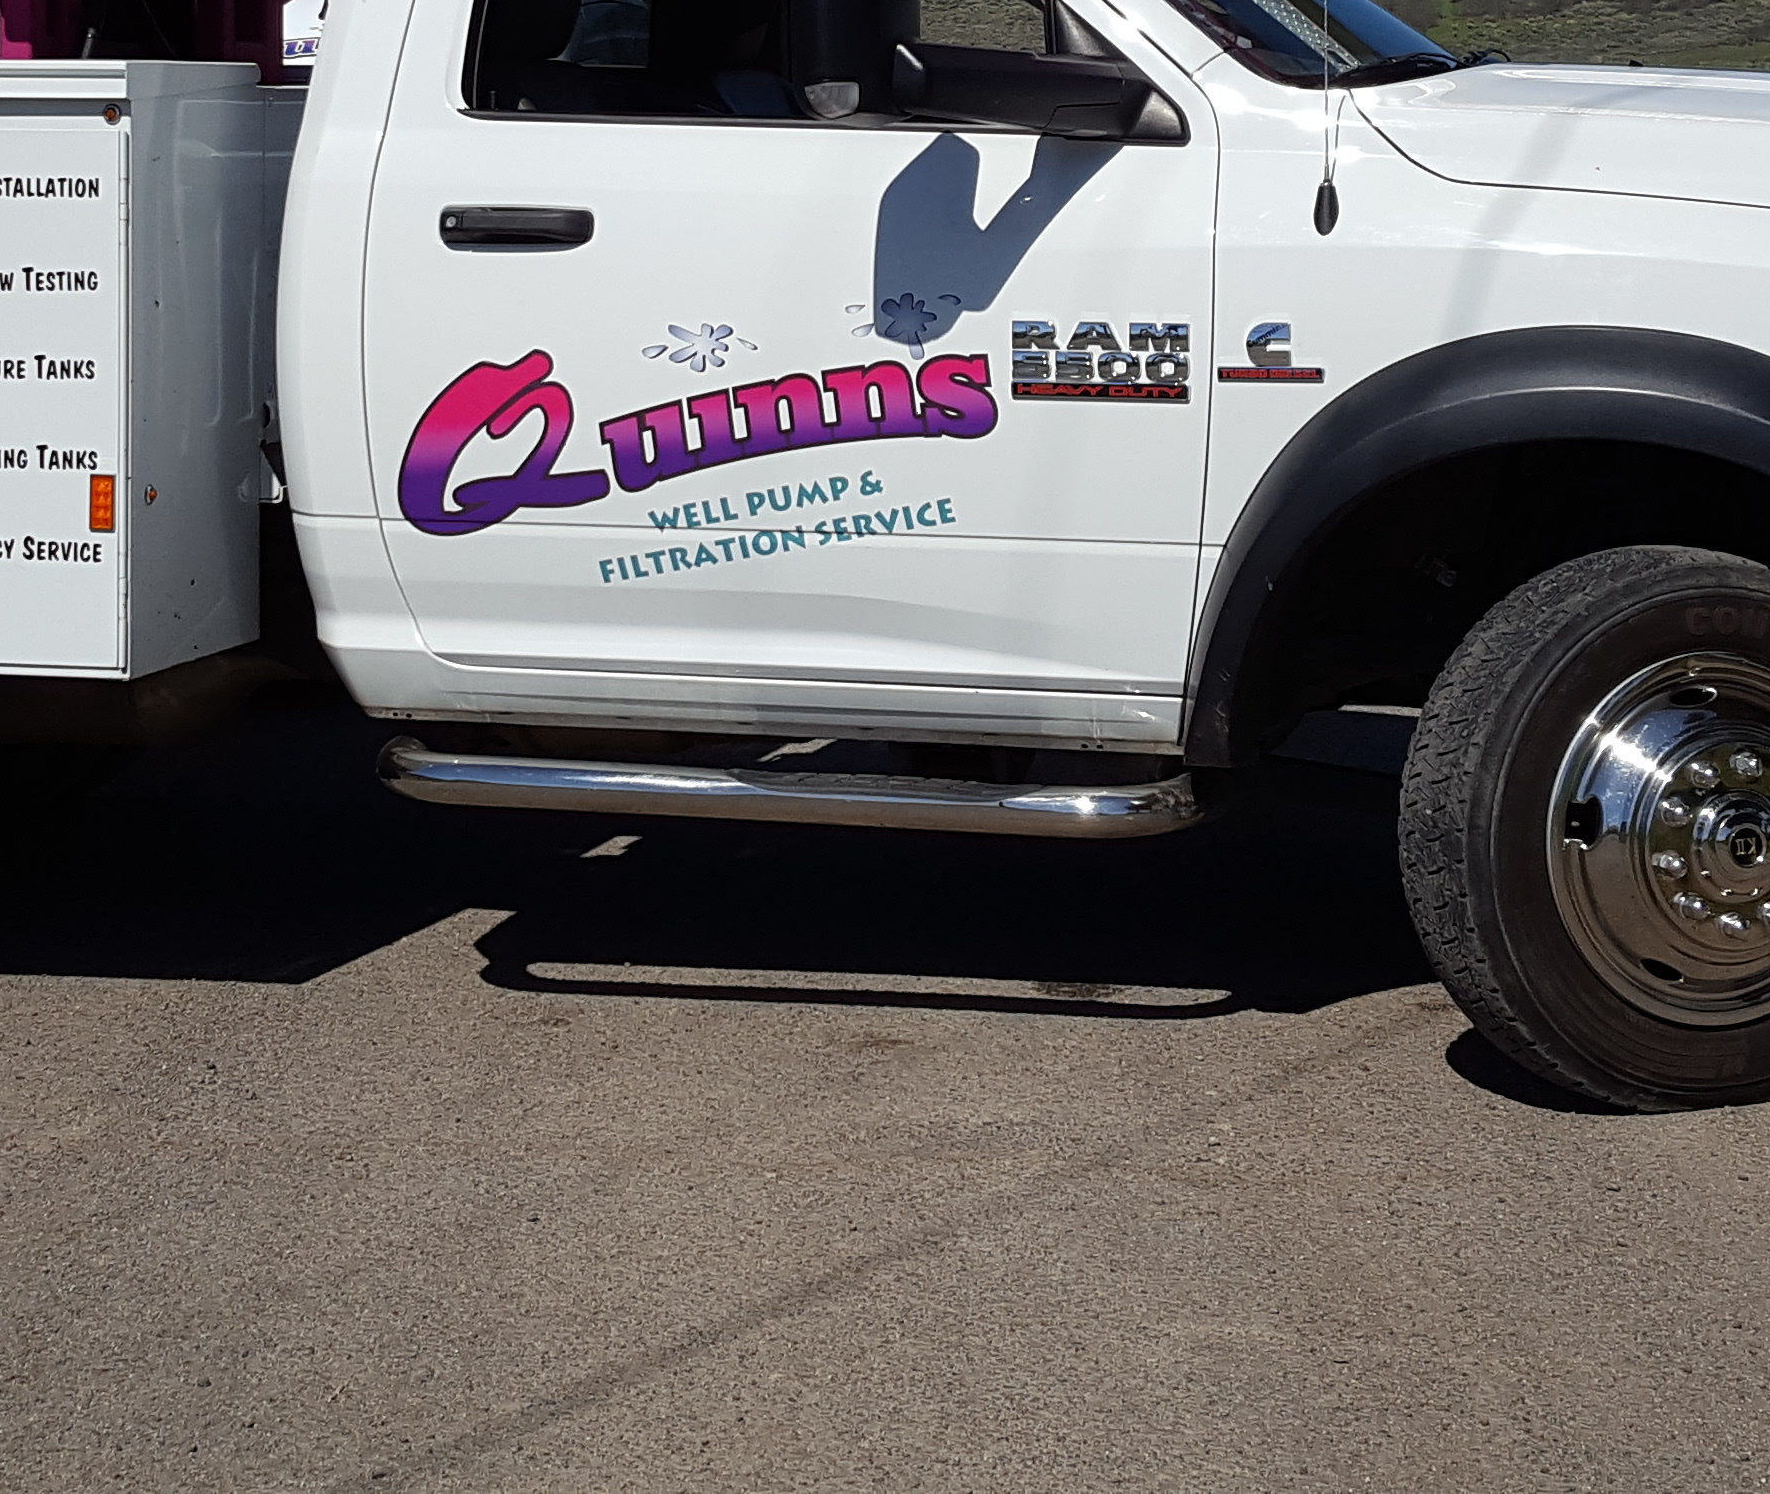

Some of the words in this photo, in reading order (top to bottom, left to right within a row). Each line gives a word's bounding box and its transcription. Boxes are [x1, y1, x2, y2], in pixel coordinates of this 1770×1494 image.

[1011, 320, 1191, 352] RAM
[1011, 350, 1191, 383] 5500
[1016, 383, 1107, 398] HEAVY
[1108, 384, 1183, 399] DUTY
[397, 348, 1000, 538] Quinns
[646, 494, 740, 534] WELL
[747, 478, 852, 518] PUMP
[858, 469, 885, 496] &
[597, 525, 808, 585] FILTRATION
[814, 496, 958, 550] SERVICE
